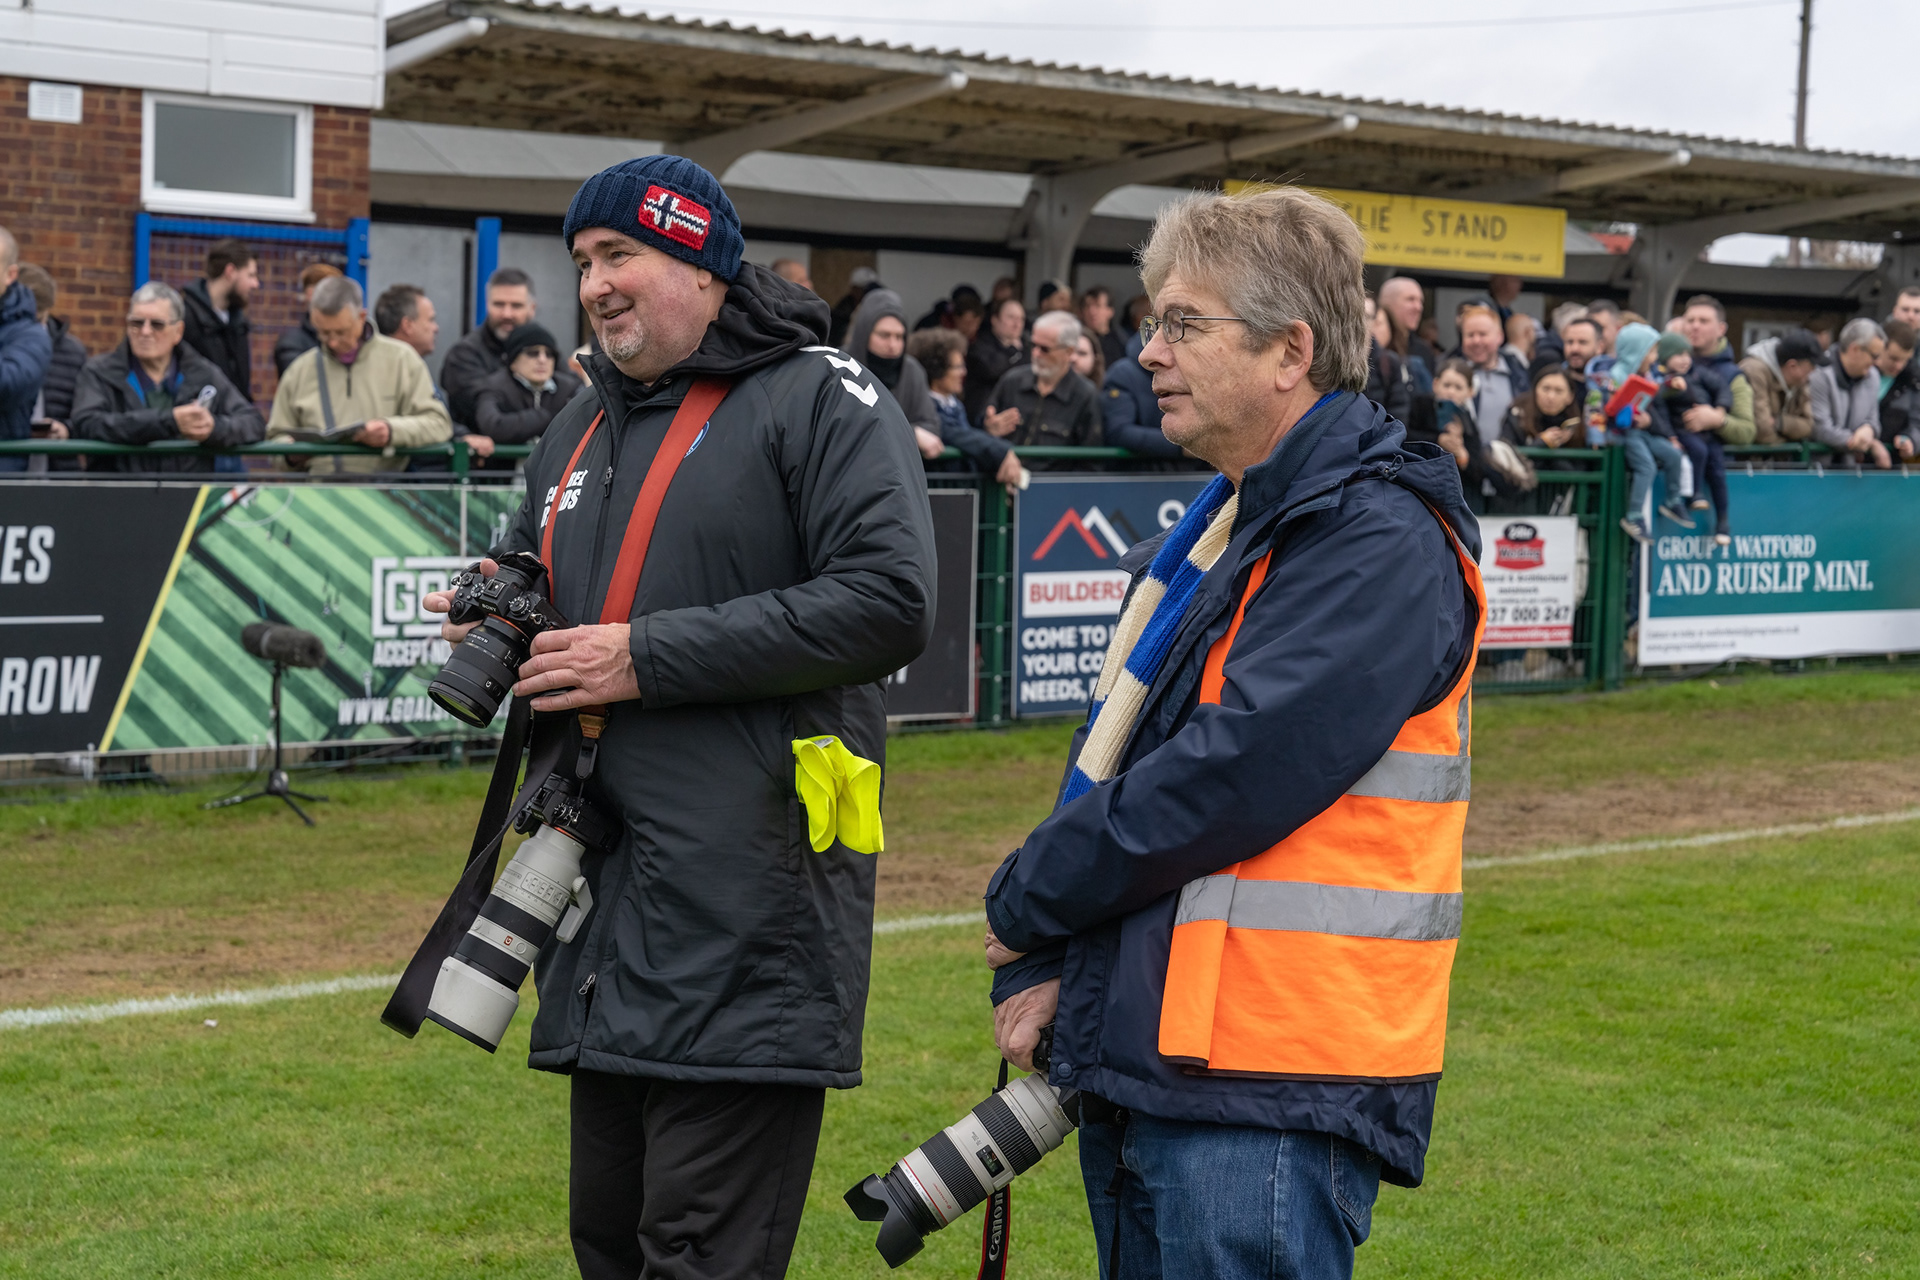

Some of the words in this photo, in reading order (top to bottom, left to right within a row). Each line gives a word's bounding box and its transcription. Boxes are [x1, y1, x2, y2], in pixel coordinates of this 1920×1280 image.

[1422, 209, 1508, 242] STAND
[0, 525, 55, 584] ES
[1657, 535, 1718, 560] GROUP
[1734, 534, 1817, 559] WATFORD
[1656, 562, 1712, 596] AND
[1715, 560, 1810, 595] RUISLIP
[1029, 580, 1125, 604] BUILDERS
[1544, 605, 1571, 622] 247
[1021, 625, 1078, 650] COME
[1078, 624, 1108, 648] TO
[372, 639, 431, 668] ACCEPT
[1021, 651, 1078, 677] YOUR
[1078, 650, 1105, 675] CO
[1020, 677, 1088, 704] NEEDS,
[988, 1192, 1004, 1262] Canon
